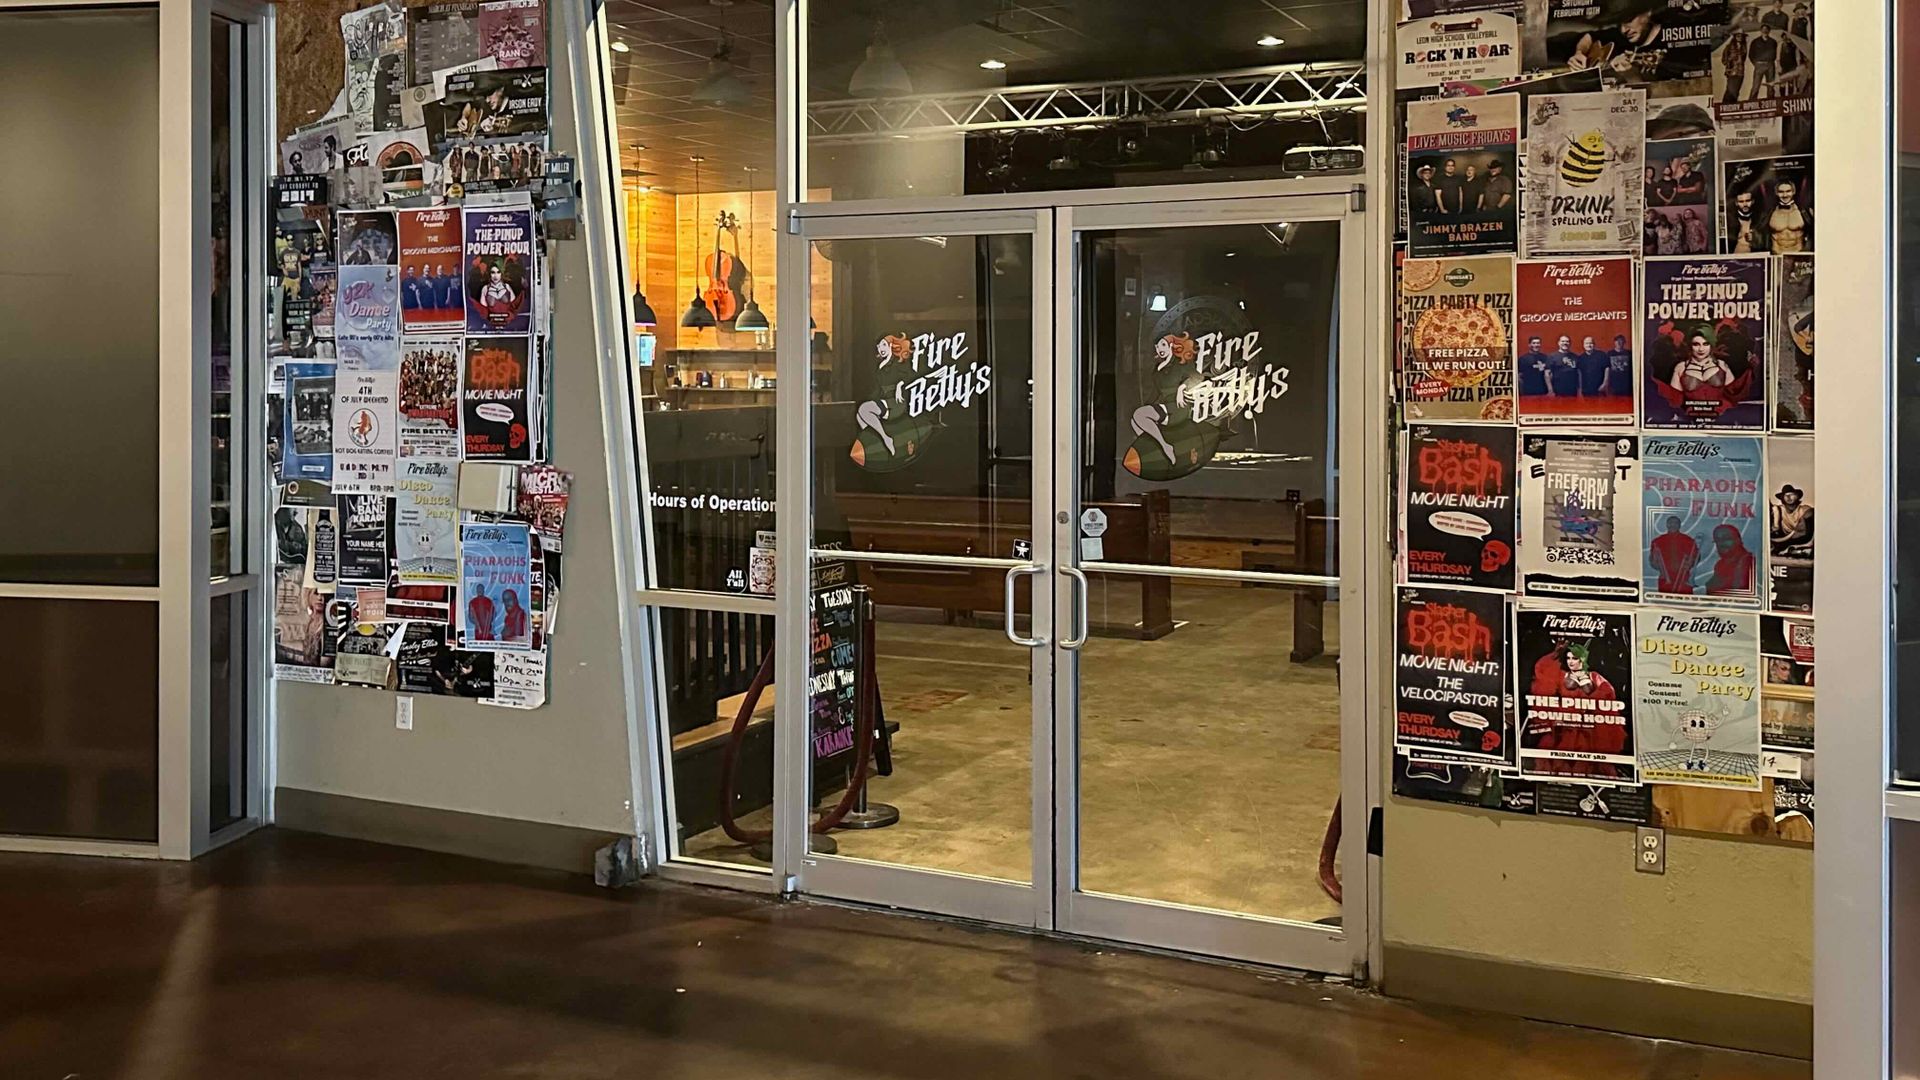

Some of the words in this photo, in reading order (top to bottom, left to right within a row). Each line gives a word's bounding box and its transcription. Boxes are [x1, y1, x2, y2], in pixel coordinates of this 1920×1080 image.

[1553, 9, 1584, 18] FEBRUARY
[1445, 34, 1466, 42] SCHOOL
[1467, 31, 1498, 39] VOLLEYBALL
[1661, 27, 1694, 42] JASON
[1405, 49, 1447, 64] ROCK
[1450, 48, 1464, 60] 'N
[1467, 44, 1510, 59] ROAR
[1782, 98, 1813, 114] SHINY
[1414, 135, 1436, 149] LIVE
[1438, 132, 1470, 147] MUSIC
[1471, 129, 1511, 145] FRIDAYS
[1550, 195, 1616, 215] DRUNK
[1422, 224, 1456, 235] JIMMY
[1460, 221, 1504, 232] BRAZEN
[1551, 217, 1594, 226] SPELLING
[1596, 215, 1614, 224] BEE
[475, 229, 494, 241] THE
[495, 228, 523, 241] PINUP
[1449, 232, 1478, 242] BAND
[467, 241, 502, 256] POWER
[504, 241, 530, 256] HOUR
[1543, 264, 1566, 278] Fire
[1567, 262, 1604, 279] Betty's
[1682, 264, 1700, 275] Fire
[1556, 278, 1592, 286] Presents
[1661, 284, 1692, 301] THE
[1695, 282, 1748, 300] PINUP
[1404, 295, 1436, 310] PIZZA
[1440, 294, 1479, 309] PARTY
[1562, 297, 1583, 305] THE
[349, 302, 391, 319] Dance
[1520, 313, 1562, 323] GROOVE
[1564, 311, 1628, 322] MERCHANTS
[1648, 302, 1711, 320] POWER
[1713, 301, 1762, 320] HOUR
[366, 318, 392, 331] Party
[911, 332, 969, 373] Fire
[1195, 331, 1263, 374] Fire
[1429, 349, 1456, 358] FREE
[1456, 348, 1489, 358] PIZZA
[471, 353, 521, 386] Bash
[1436, 361, 1451, 370] WE
[1452, 361, 1476, 370] RUN
[1478, 360, 1506, 370] OUT!
[358, 386, 372, 395] 4TH
[464, 389, 495, 400] MOVIE
[495, 388, 523, 400] NIGHT
[905, 362, 991, 418] Betty's
[1186, 363, 1290, 423] Betty's
[1416, 387, 1449, 395] MONDAY
[1645, 440, 1676, 457] Fire
[1676, 439, 1721, 460] Betty's
[407, 462, 423, 478] Fire
[1418, 446, 1503, 489] Bash
[1644, 476, 1757, 494] PHARAOHS
[647, 492, 687, 508] Hours
[691, 494, 705, 509] of
[709, 495, 776, 513] Operation
[1410, 492, 1458, 506] MOVIE
[1459, 494, 1509, 509] NIGHT
[1663, 496, 1681, 507] OF
[1692, 500, 1756, 518] FUNK
[357, 504, 385, 515] BAND
[465, 528, 482, 541] Fire
[464, 555, 527, 567] PHARAOHS
[1409, 550, 1447, 561] EVERY
[728, 569, 742, 579] All
[1409, 562, 1472, 575] THURDSAY
[726, 578, 744, 588] Y'all
[820, 588, 853, 608] TUESDAY
[1407, 609, 1491, 649] Bash
[1542, 614, 1567, 629] Fire
[1568, 614, 1606, 631] Betty's
[1657, 615, 1689, 632] Fire
[1690, 616, 1737, 638] Betty's
[1641, 638, 1708, 656] Disco
[1399, 654, 1447, 671] MOVIE
[1448, 658, 1500, 676] NIGHT:
[1670, 658, 1745, 678] Dance
[1436, 676, 1464, 690] THE
[1697, 680, 1755, 701] Party
[1400, 686, 1498, 707] VELOCIPASTOR
[1525, 695, 1559, 708] THE
[1561, 697, 1596, 711] PIN
[1599, 700, 1626, 712] UP
[1399, 711, 1435, 725] EVERY
[1528, 710, 1582, 722] POWER
[1583, 713, 1626, 726] HOUR
[1399, 723, 1460, 739] THURDSAY
